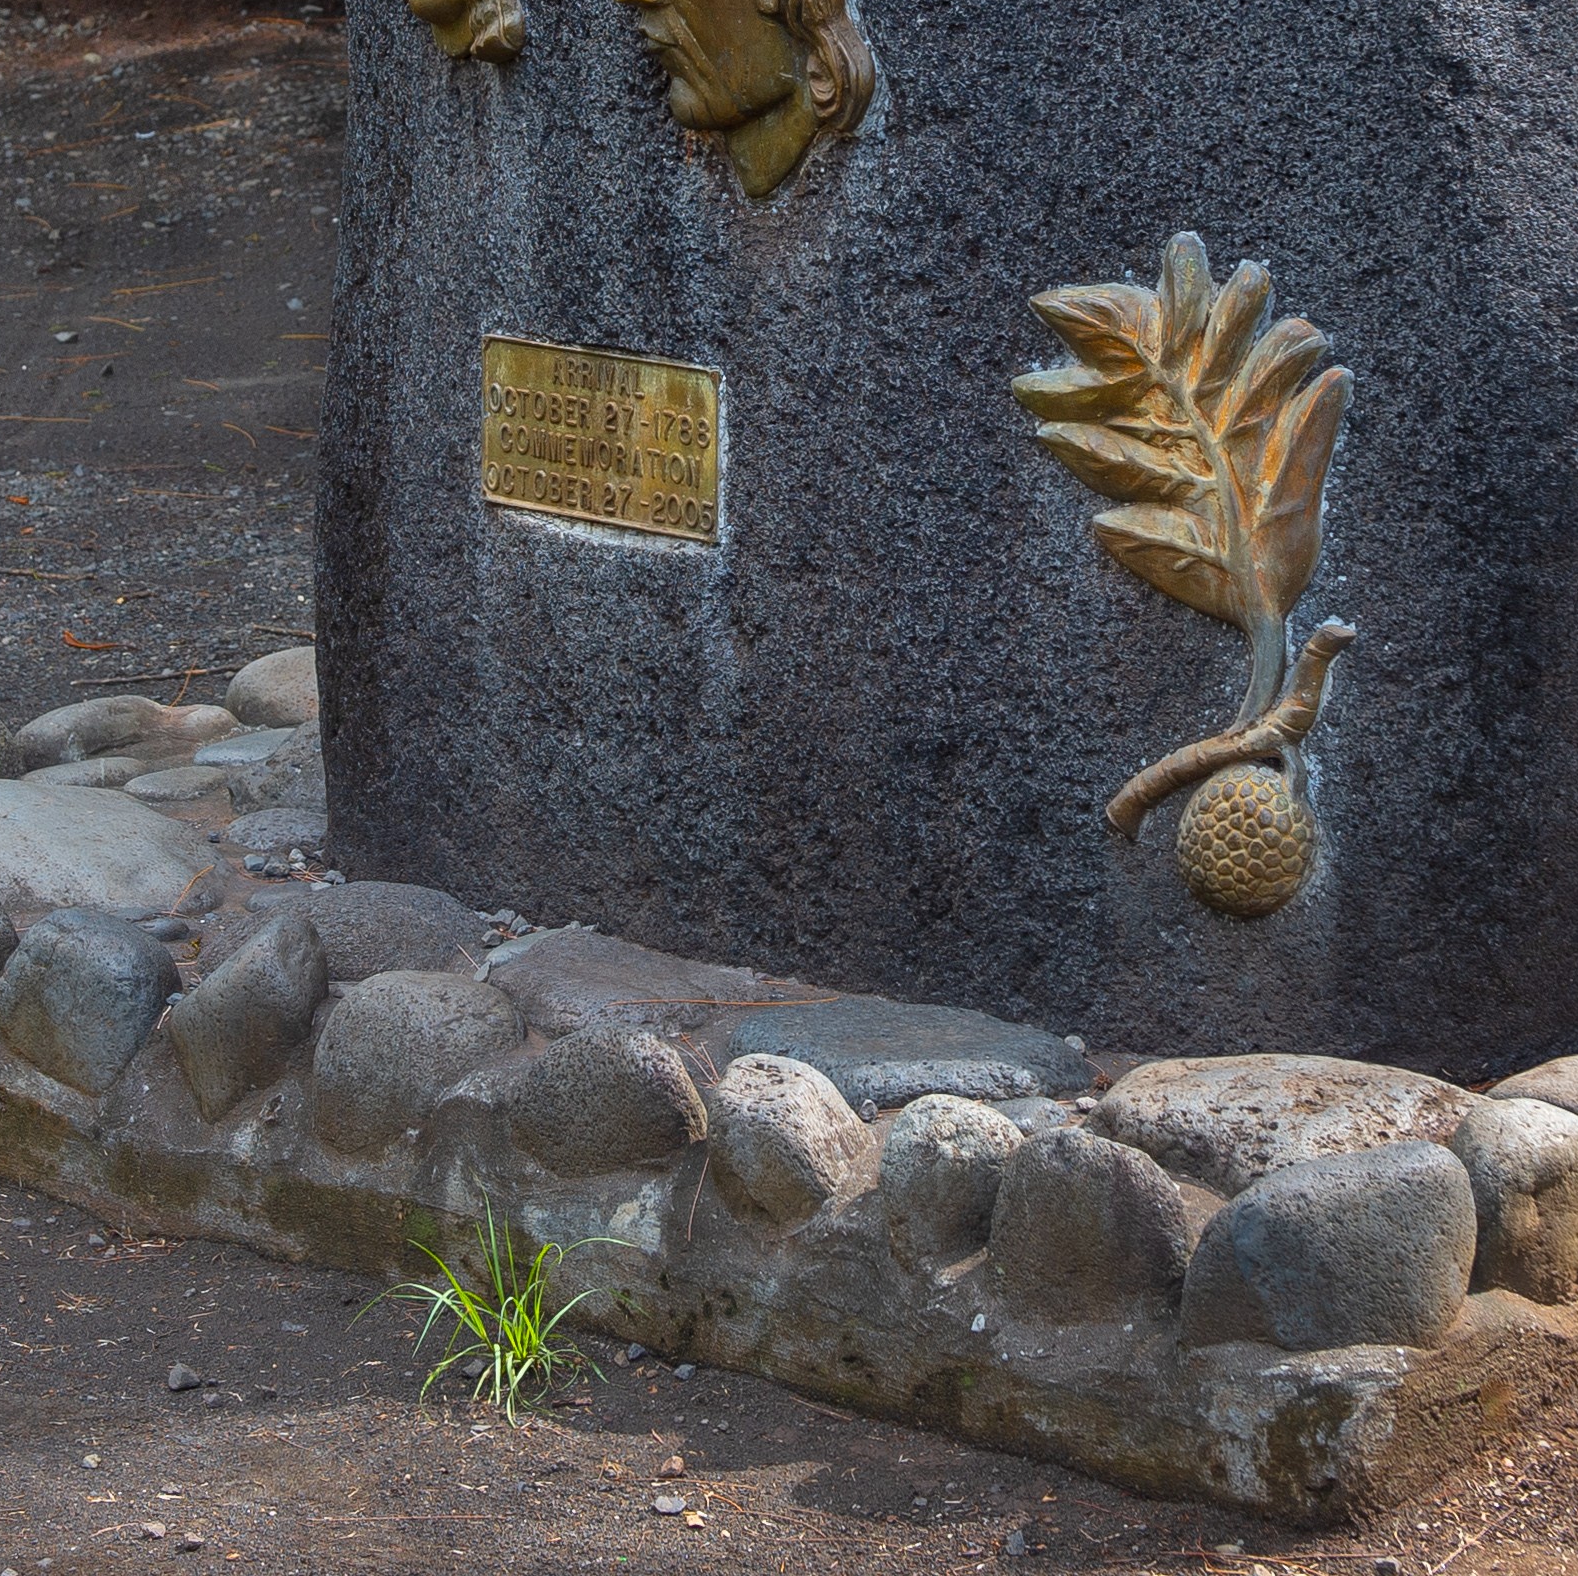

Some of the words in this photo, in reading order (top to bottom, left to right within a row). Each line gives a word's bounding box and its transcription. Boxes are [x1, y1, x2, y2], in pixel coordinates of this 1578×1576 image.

[553, 355, 645, 400] ARRIVAL
[488, 381, 591, 430] OCTOBER
[500, 422, 703, 489] COMMEMORATION
[485, 461, 593, 511] OCTOBER
